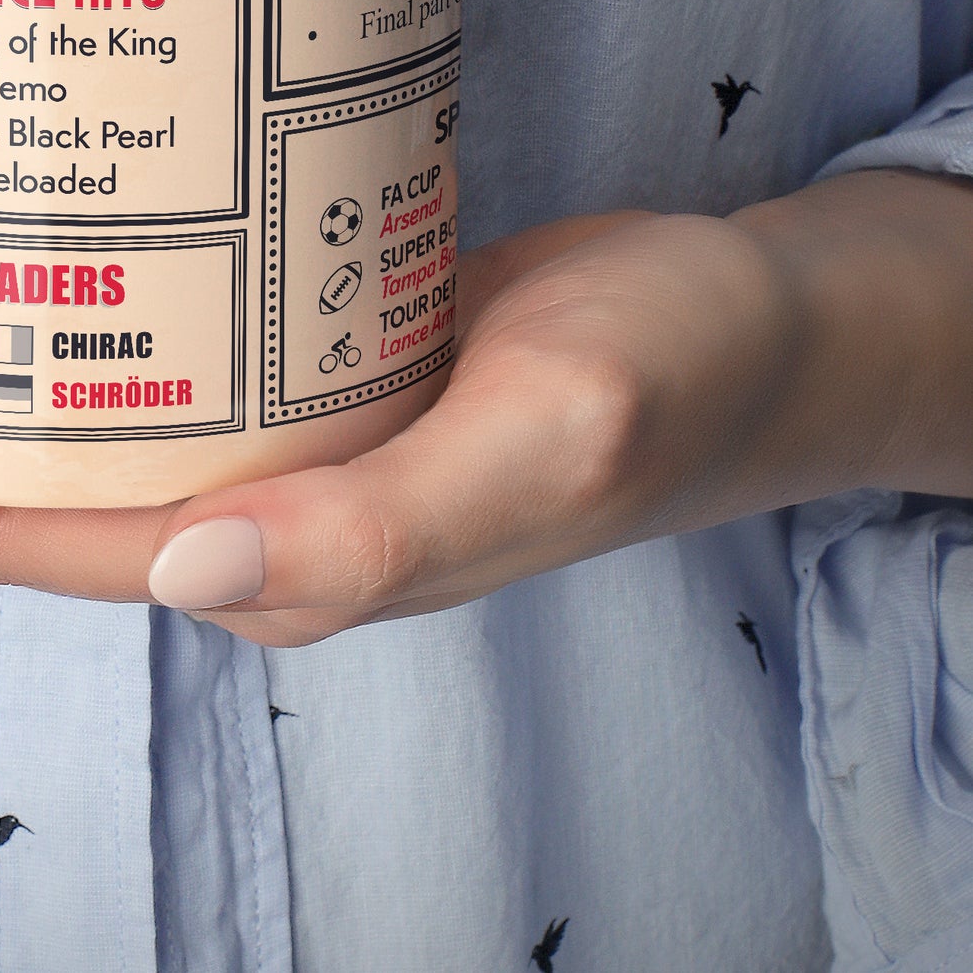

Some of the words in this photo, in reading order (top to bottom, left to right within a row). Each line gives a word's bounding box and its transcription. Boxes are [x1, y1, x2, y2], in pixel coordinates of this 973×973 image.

[360, 0, 413, 39] Final
[9, 22, 37, 63] of
[50, 24, 97, 56] the
[108, 27, 177, 63] King
[9, 116, 91, 149] Black
[102, 116, 175, 149] Pearl
[382, 183, 403, 210] FA
[407, 165, 441, 199] CUP
[379, 187, 443, 238] Arsenal
[380, 229, 435, 273] SUPER
[382, 260, 436, 299] Tampa
[379, 294, 429, 333] TOUR
[432, 279, 449, 309] DE
[51, 331, 153, 359] CHIRAC
[379, 325, 429, 360] Lance
[51, 376, 193, 410] SCHRÖDER
